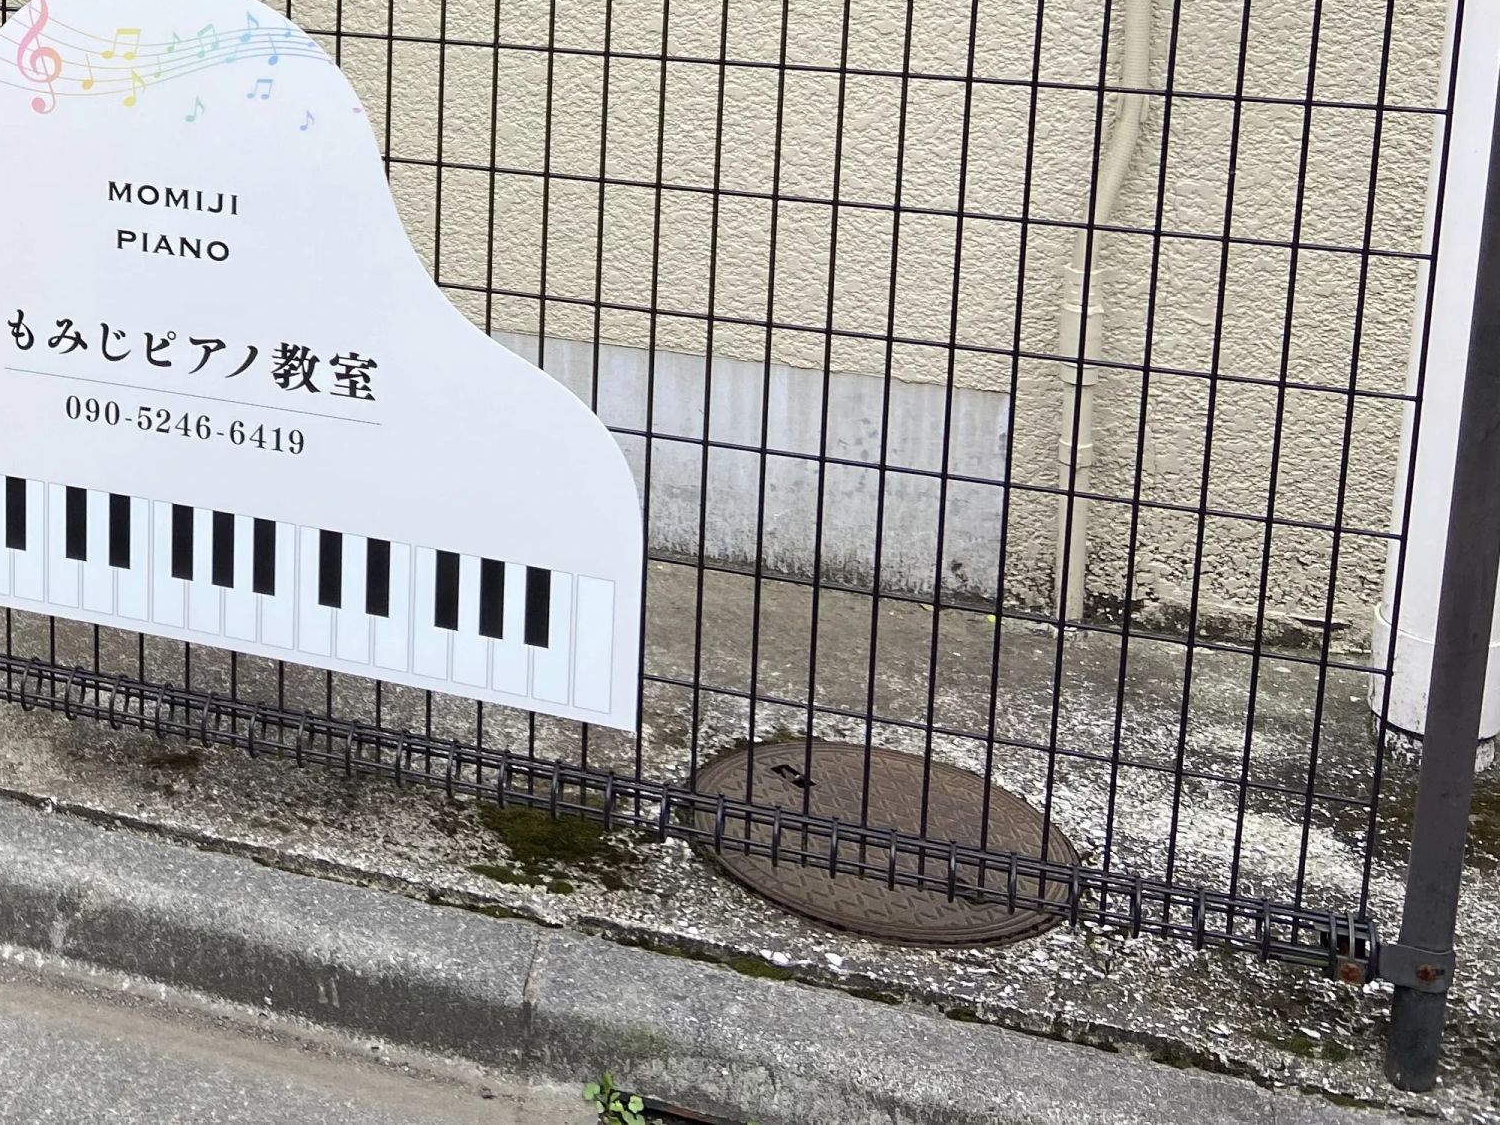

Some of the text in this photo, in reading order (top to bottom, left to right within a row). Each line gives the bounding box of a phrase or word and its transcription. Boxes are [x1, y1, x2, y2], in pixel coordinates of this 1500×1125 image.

[107, 179, 239, 217] MOMIJI
[116, 228, 231, 263] PIANO
[6, 307, 379, 403] もみじピアノ教室
[64, 394, 306, 456] 090-5246-6419
